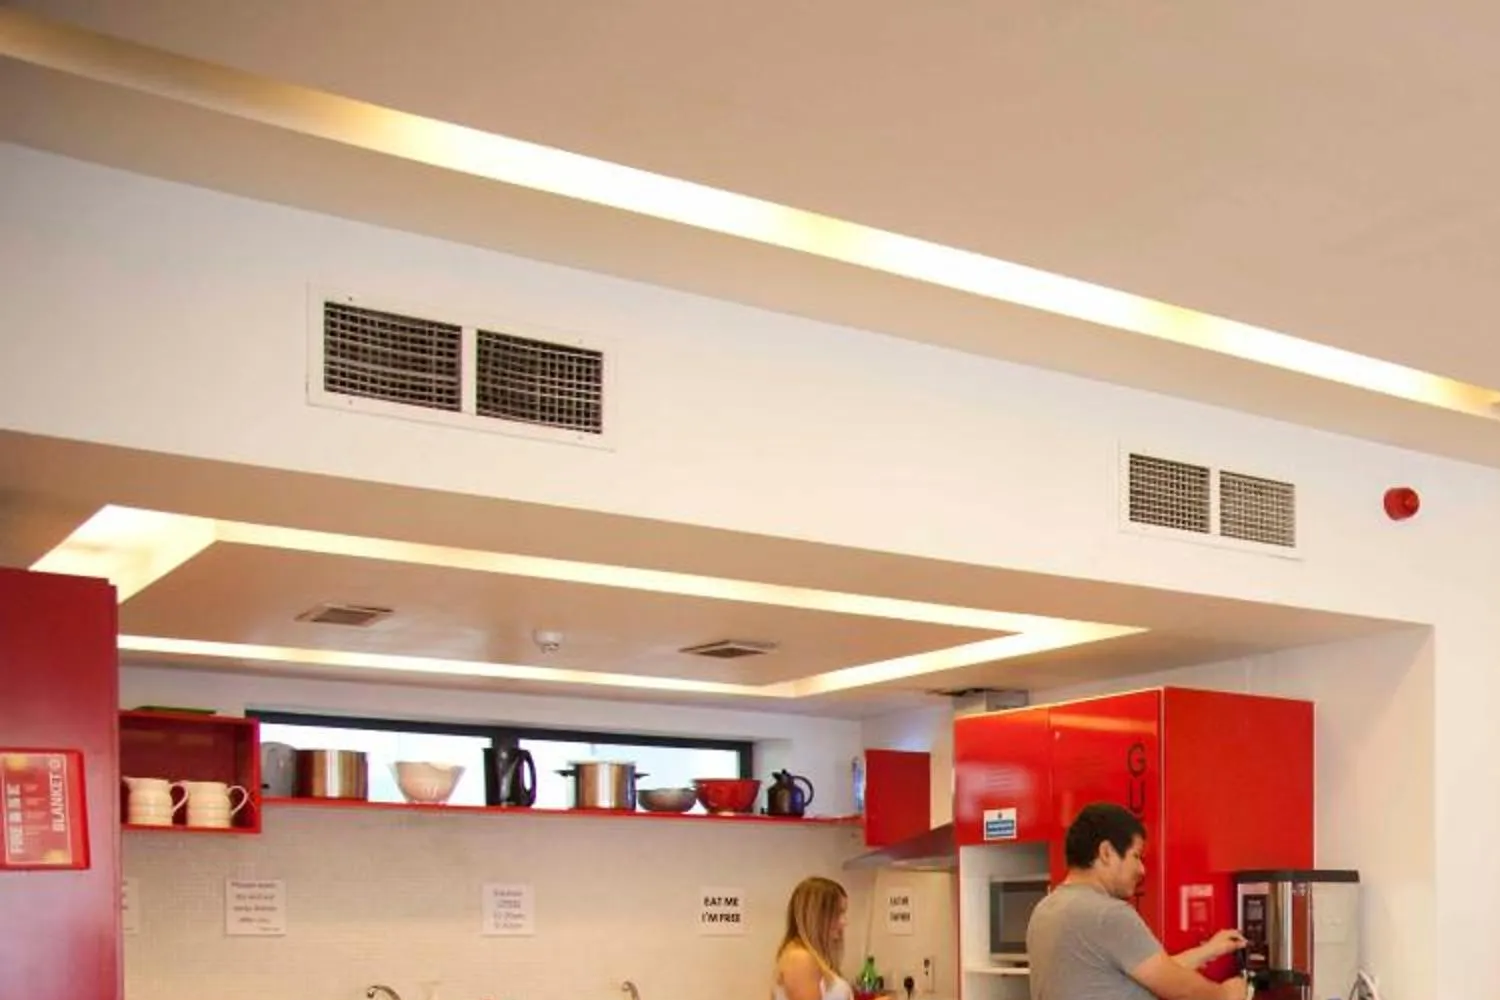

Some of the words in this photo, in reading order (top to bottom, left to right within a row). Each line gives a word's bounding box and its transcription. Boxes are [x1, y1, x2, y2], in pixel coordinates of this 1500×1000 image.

[49, 772, 65, 832] BLANKET
[703, 896, 722, 906] EAT
[724, 896, 739, 906] ME
[701, 912, 718, 922] I'M
[719, 913, 741, 922] FREE
